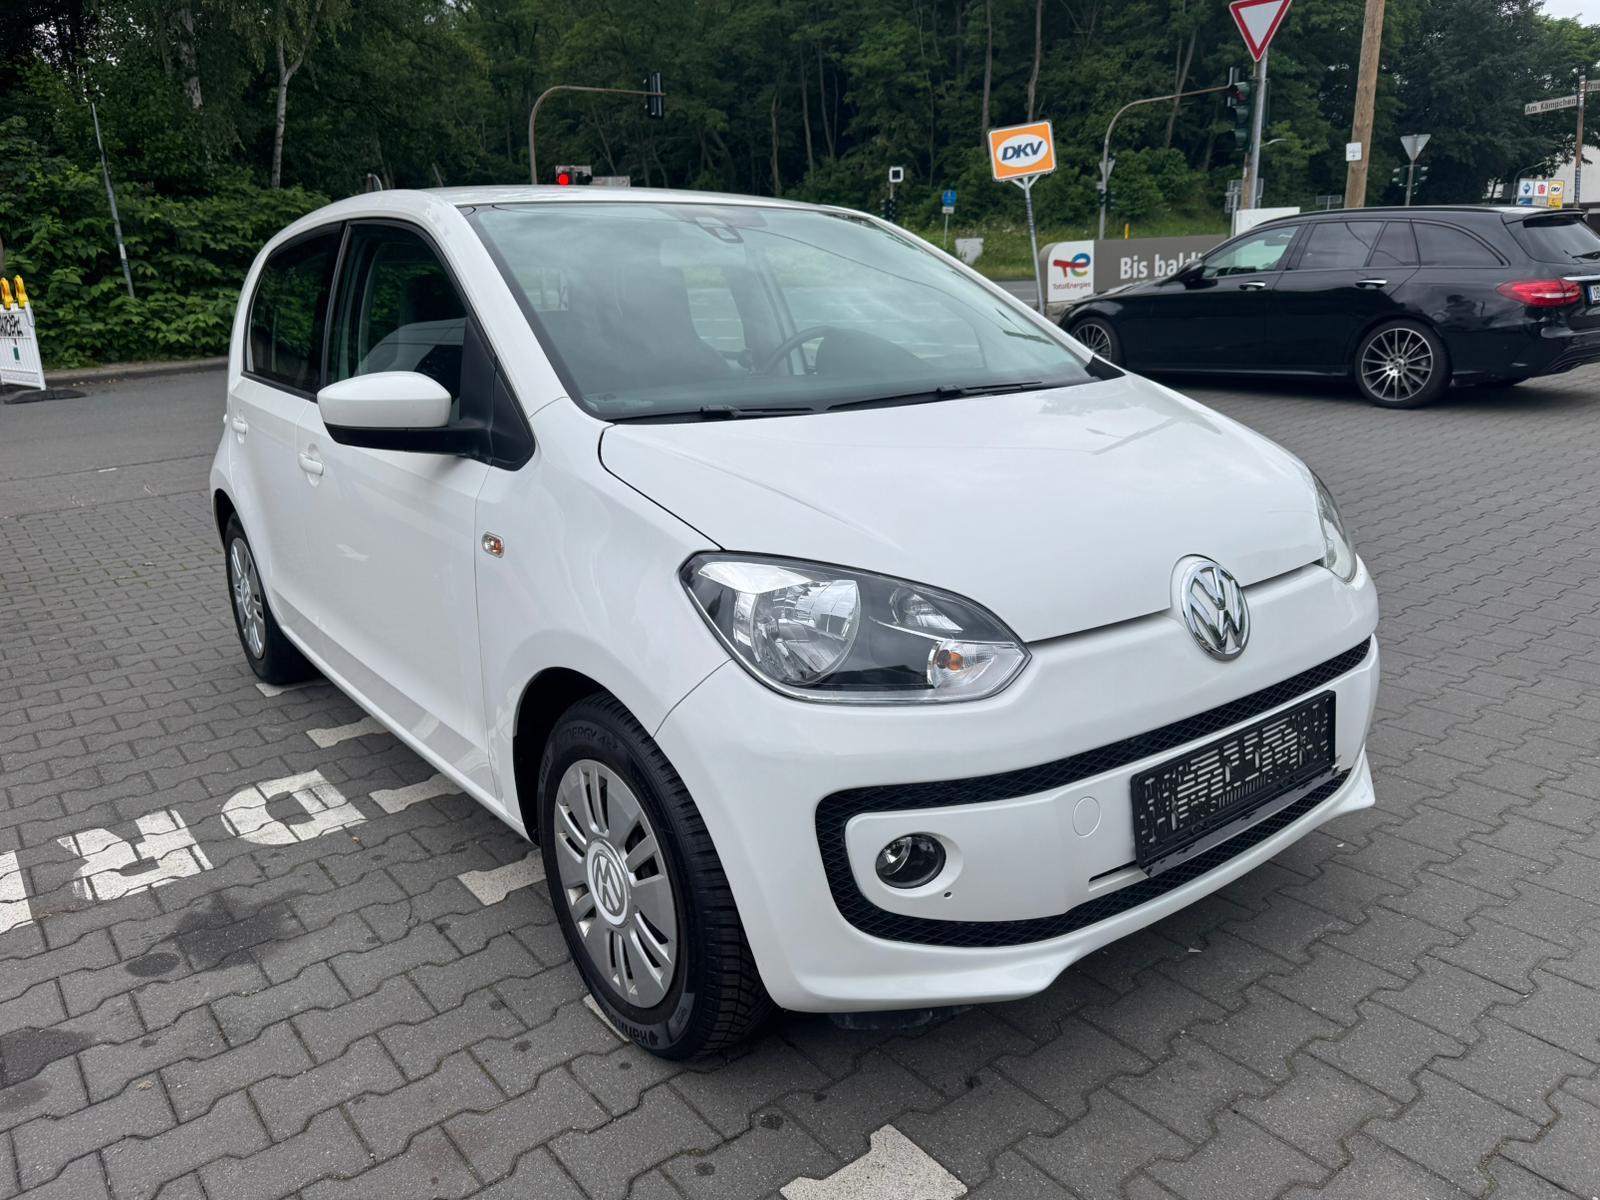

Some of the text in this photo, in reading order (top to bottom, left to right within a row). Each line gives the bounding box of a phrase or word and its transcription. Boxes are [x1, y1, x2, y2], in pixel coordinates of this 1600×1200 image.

[1526, 105, 1537, 113] Am
[1001, 140, 1044, 161] DKV
[1120, 252, 1202, 279] Bis bal
[1052, 281, 1091, 290] TotalEnergies
